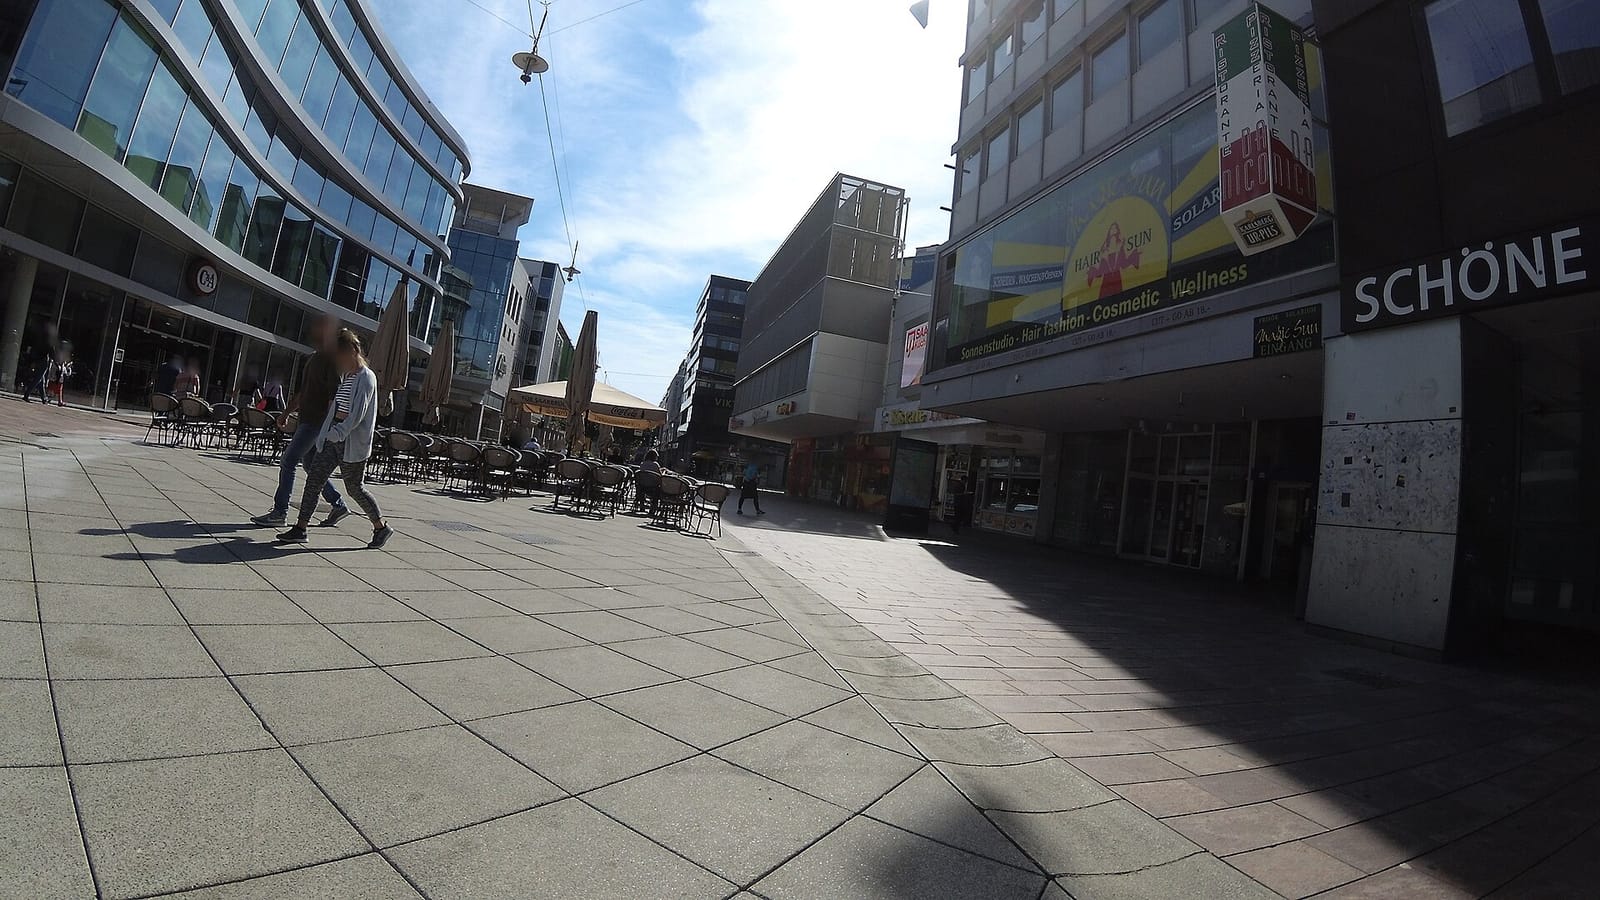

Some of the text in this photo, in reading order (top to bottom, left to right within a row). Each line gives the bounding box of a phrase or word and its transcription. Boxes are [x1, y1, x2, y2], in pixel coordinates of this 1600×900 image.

[1215, 32, 1232, 157] RISTORANTE
[1074, 228, 1152, 273] HAIR SUN
[1354, 226, 1587, 323] SCHÖNE
[960, 334, 1014, 360] Sonnenstudio
[1021, 322, 1041, 343] Hair
[1044, 313, 1085, 337] fashion
[1093, 289, 1160, 323] Cosmetic
[1171, 263, 1248, 300] Wellness
